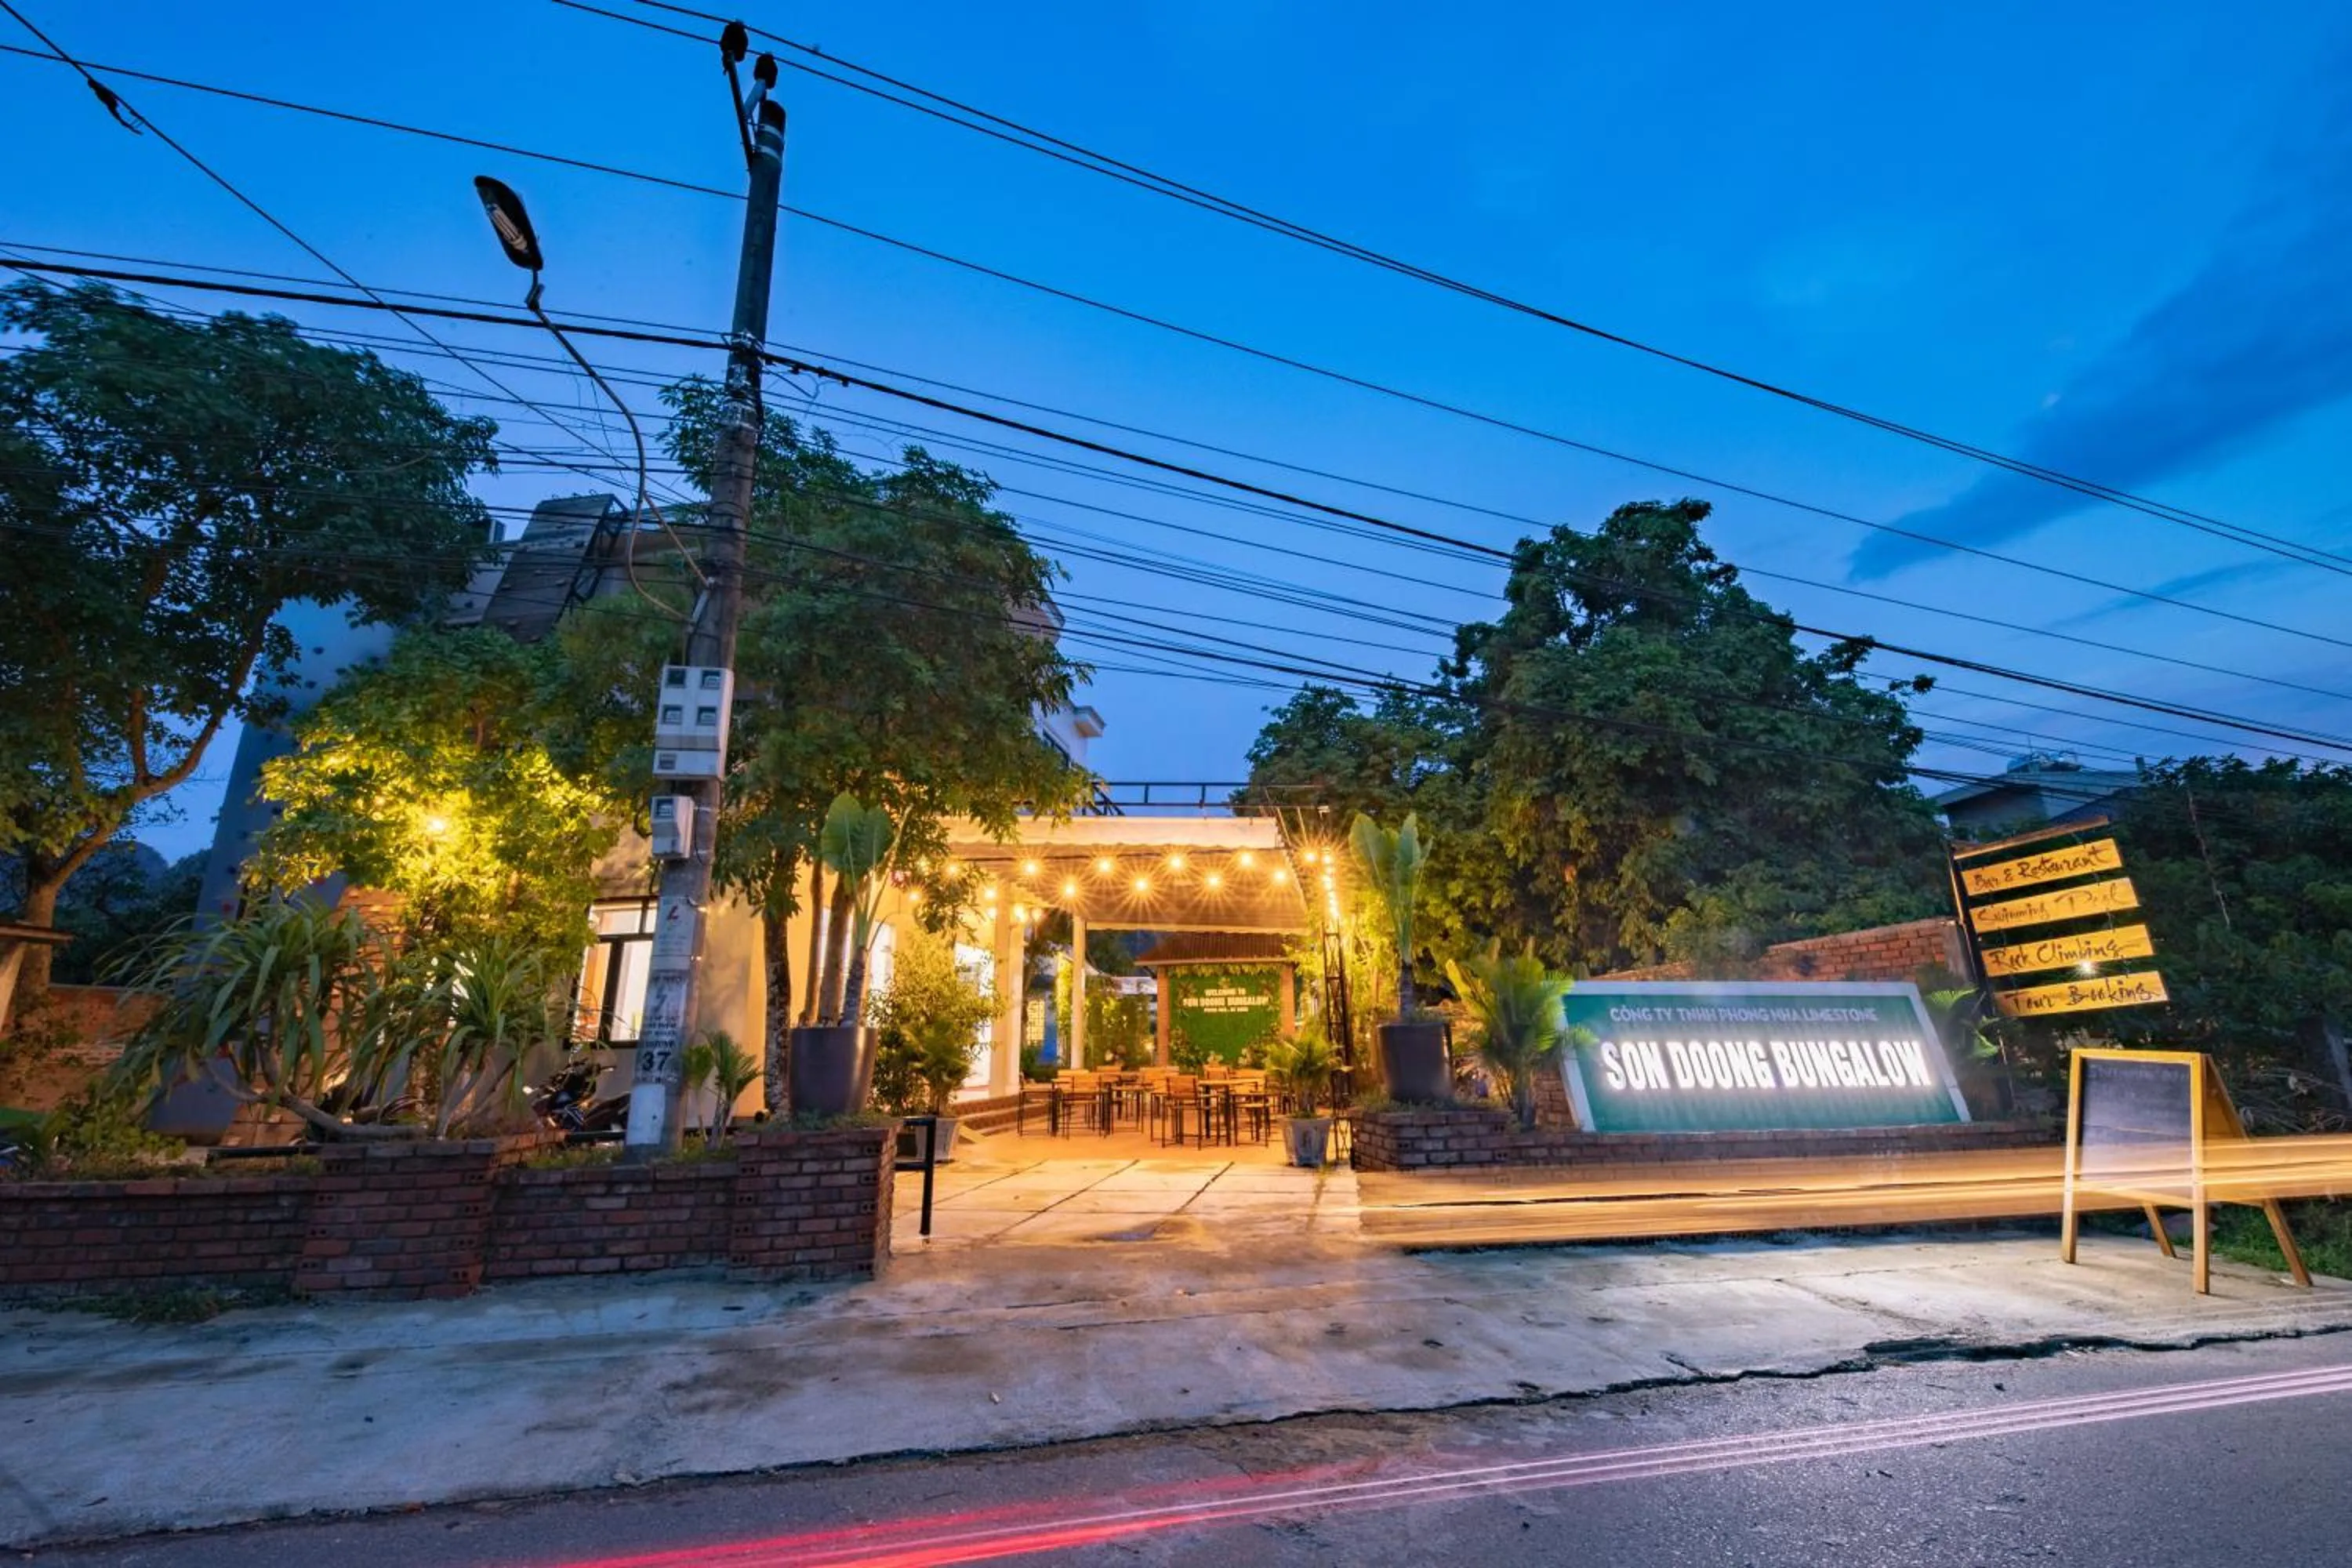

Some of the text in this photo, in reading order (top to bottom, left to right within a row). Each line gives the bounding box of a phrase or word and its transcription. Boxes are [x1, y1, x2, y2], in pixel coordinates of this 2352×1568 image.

[1989, 938, 2140, 970] Rock Climbing
[2004, 978, 2160, 1011] Tour Booking
[1653, 1007, 1671, 1022] TY
[641, 1051, 671, 1071] 37
[1601, 1039, 1932, 1091] SON DOONG BUNGALOW
